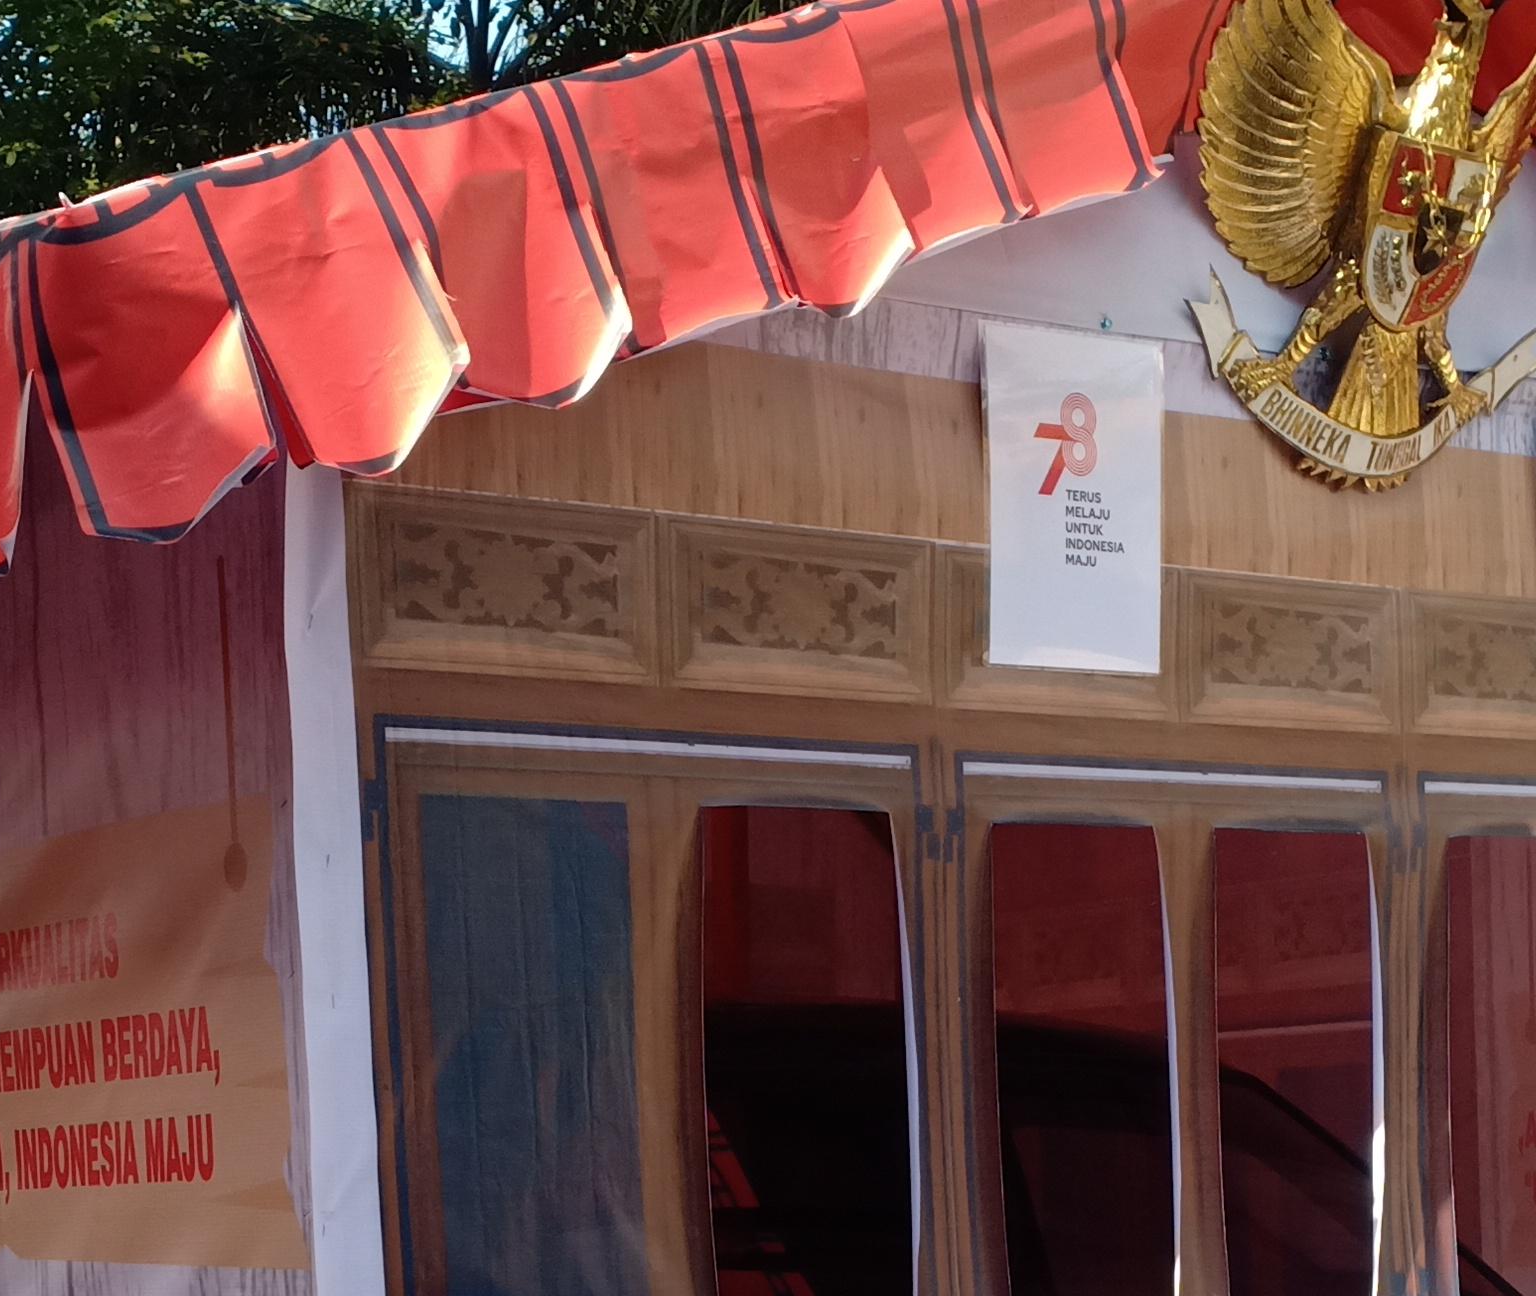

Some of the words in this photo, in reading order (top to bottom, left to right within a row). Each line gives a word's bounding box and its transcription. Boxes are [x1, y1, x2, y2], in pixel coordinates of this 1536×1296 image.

[1260, 388, 1352, 464] BHINNEKA
[1033, 392, 1098, 496] 78
[1065, 489, 1102, 504] TERUS
[1065, 506, 1111, 521] MELAJU
[1065, 522, 1104, 537] UNTUK
[1065, 538, 1125, 554] INDONESIA
[1065, 554, 1097, 568] MAJU
[100, 1005, 222, 1086] BERDAYA,
[14, 1120, 139, 1190] INDONESIA
[144, 1113, 215, 1185] MAJU
